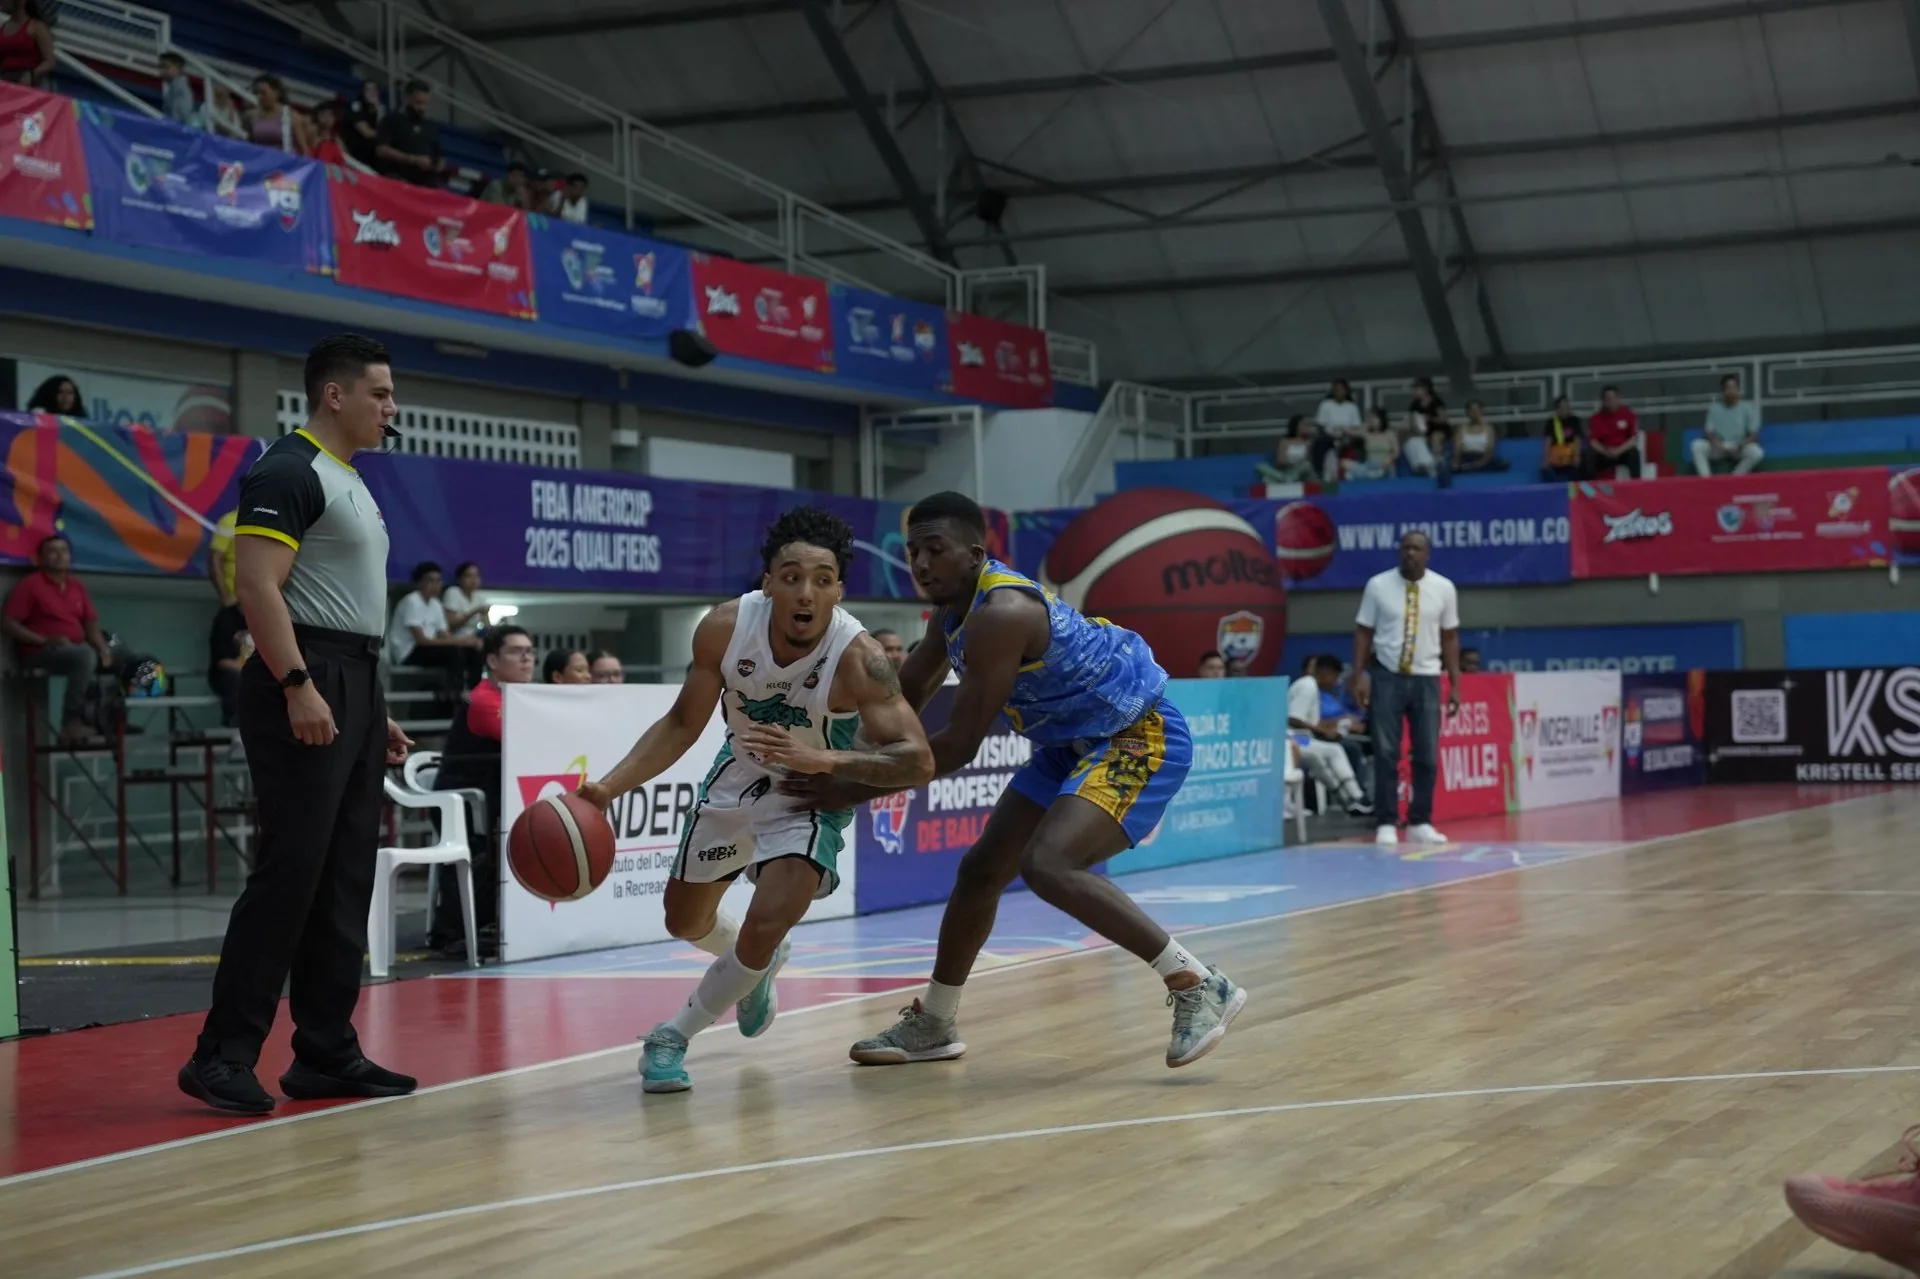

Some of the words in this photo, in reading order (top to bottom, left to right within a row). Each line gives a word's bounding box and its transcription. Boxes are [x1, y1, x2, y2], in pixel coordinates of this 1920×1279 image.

[530, 479, 570, 522] FIBA
[572, 483, 654, 528] AMERICUP
[525, 526, 571, 569] 2025
[572, 529, 662, 574] QUALIFIERS
[965, 730, 1032, 769] VISIÓN
[1232, 740, 1248, 767] DE
[1797, 763, 1884, 780] KRISTELL
[604, 781, 704, 840] NDER
[917, 821, 942, 853] DE
[636, 854, 652, 871] del
[699, 849, 737, 861] TECH
[613, 881, 623, 898] la
